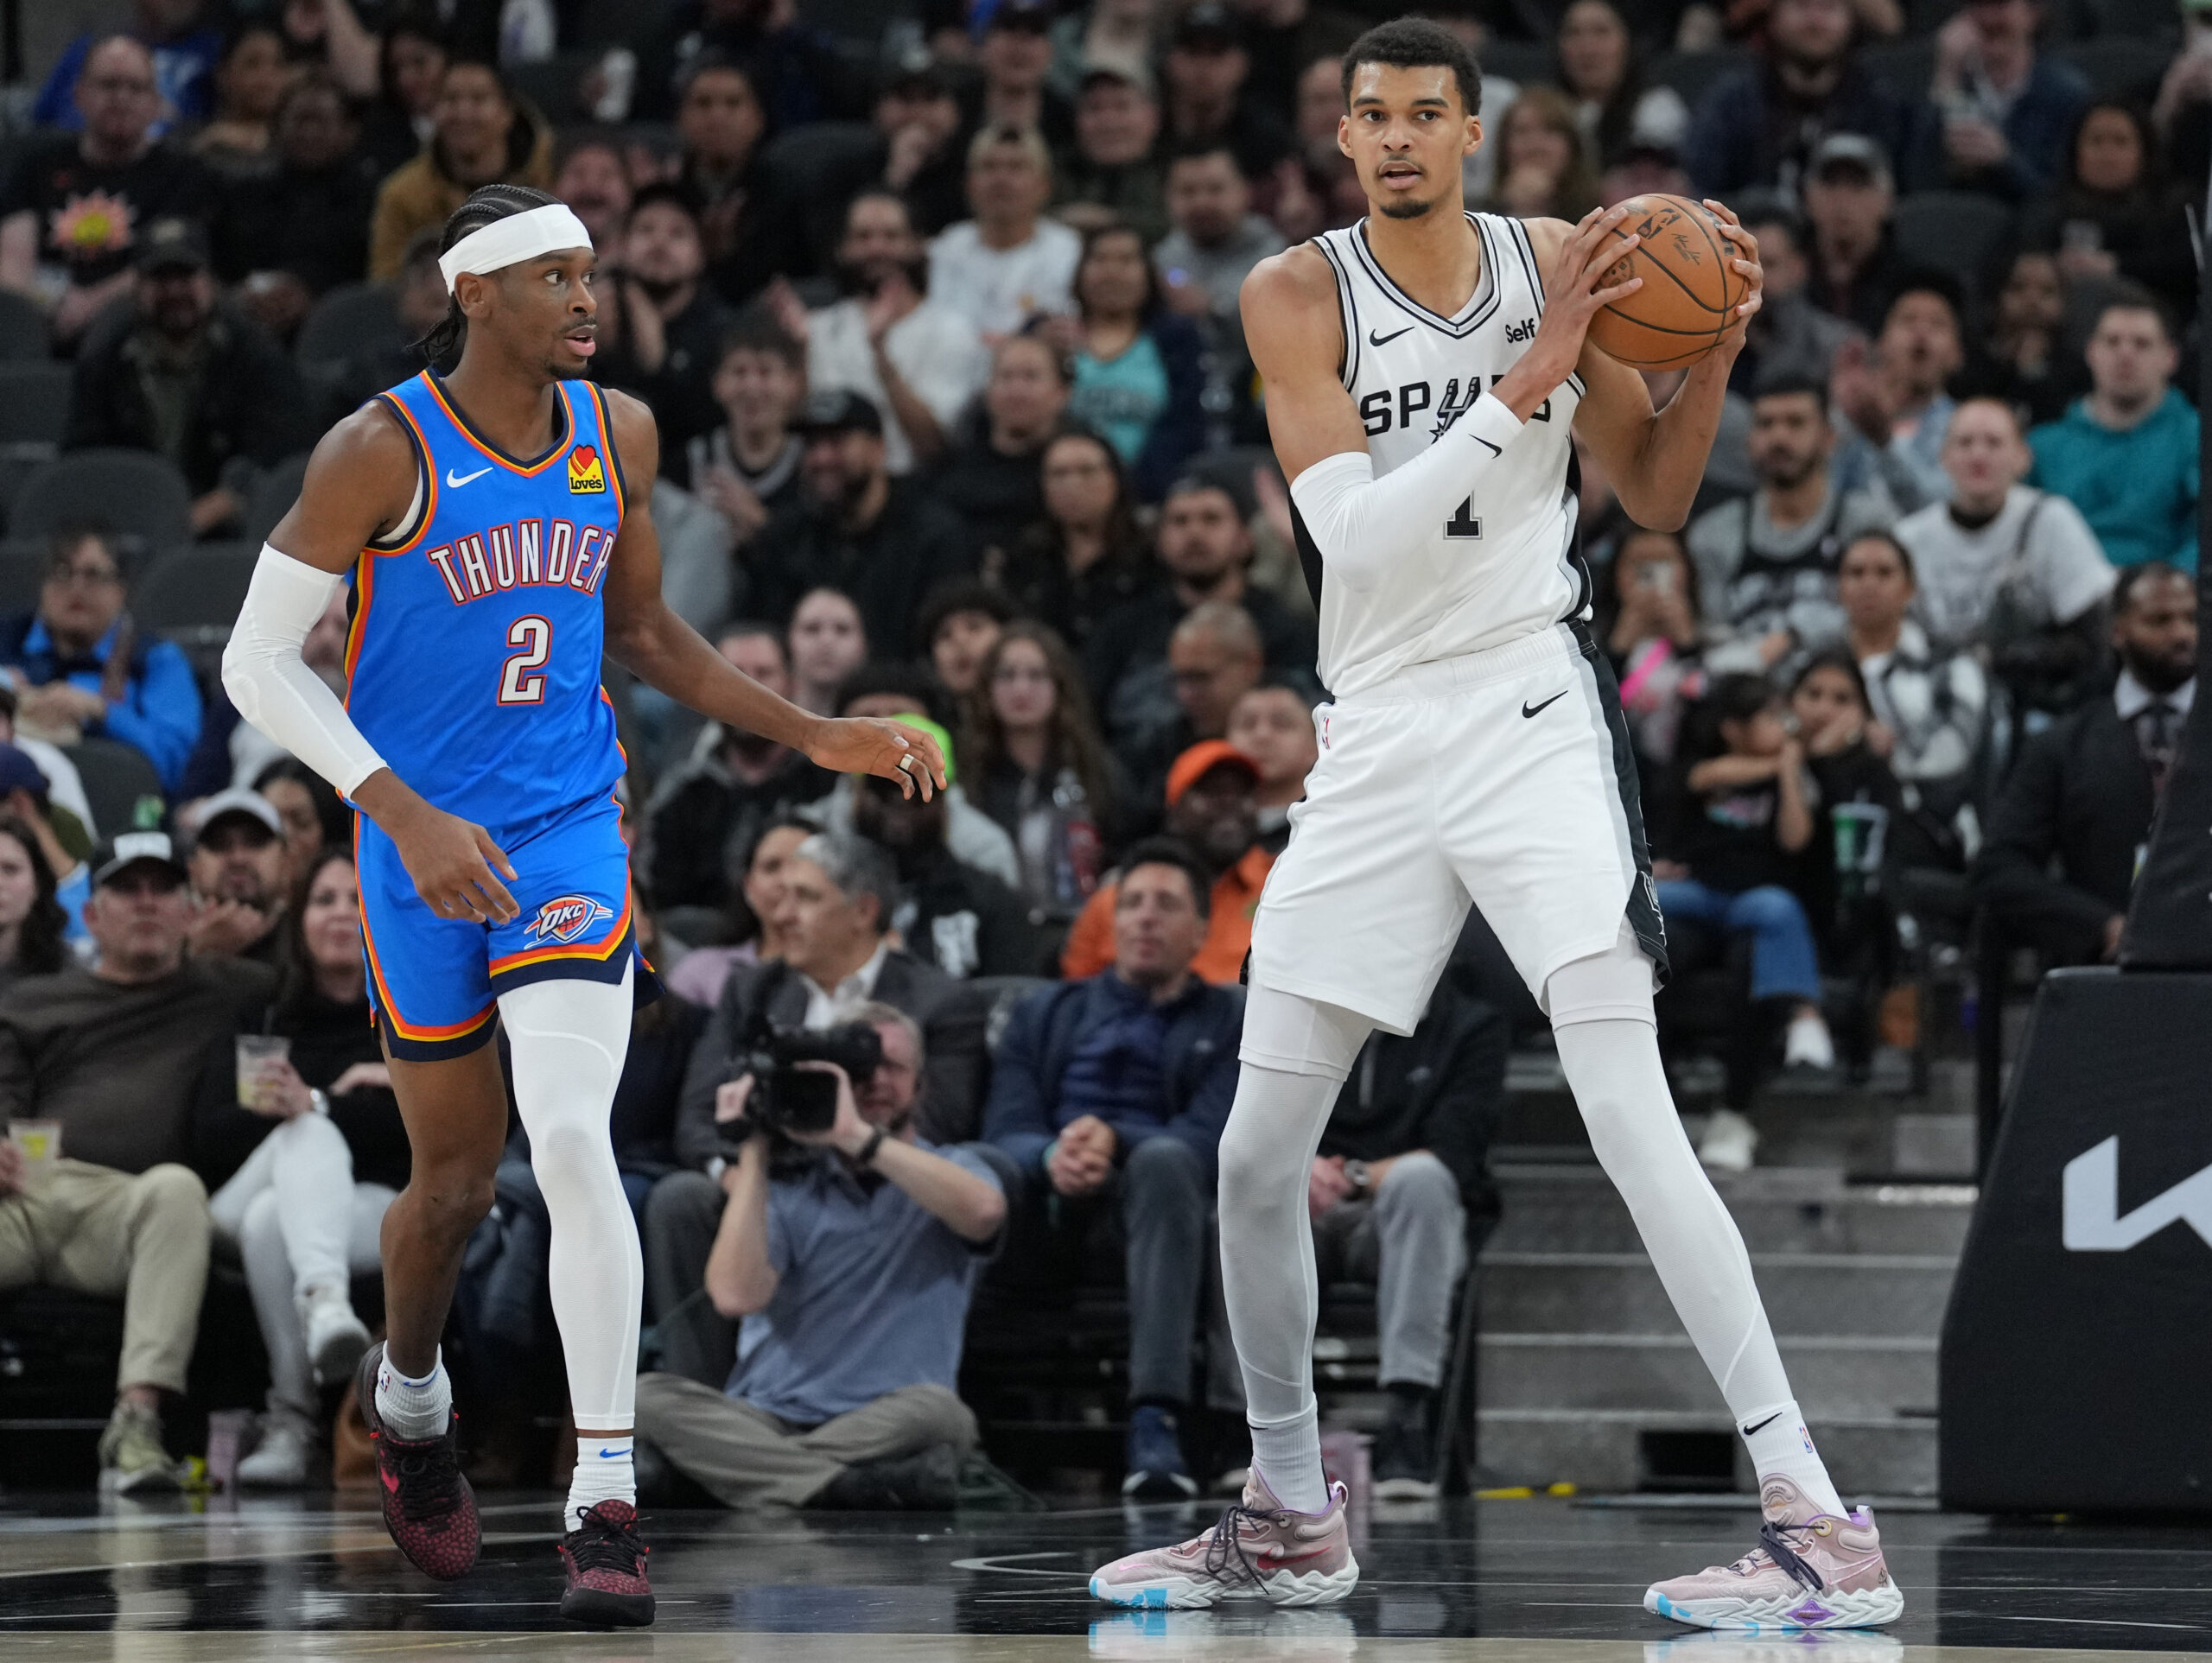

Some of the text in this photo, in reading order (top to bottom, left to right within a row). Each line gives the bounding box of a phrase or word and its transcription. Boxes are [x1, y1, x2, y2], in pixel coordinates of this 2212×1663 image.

[1505, 318, 1535, 344] Self
[1360, 375, 1551, 444] SPU
[1442, 490, 1484, 541] 1
[425, 517, 615, 606] THUNDER
[497, 613, 553, 706] 2
[537, 903, 585, 938] OKC
